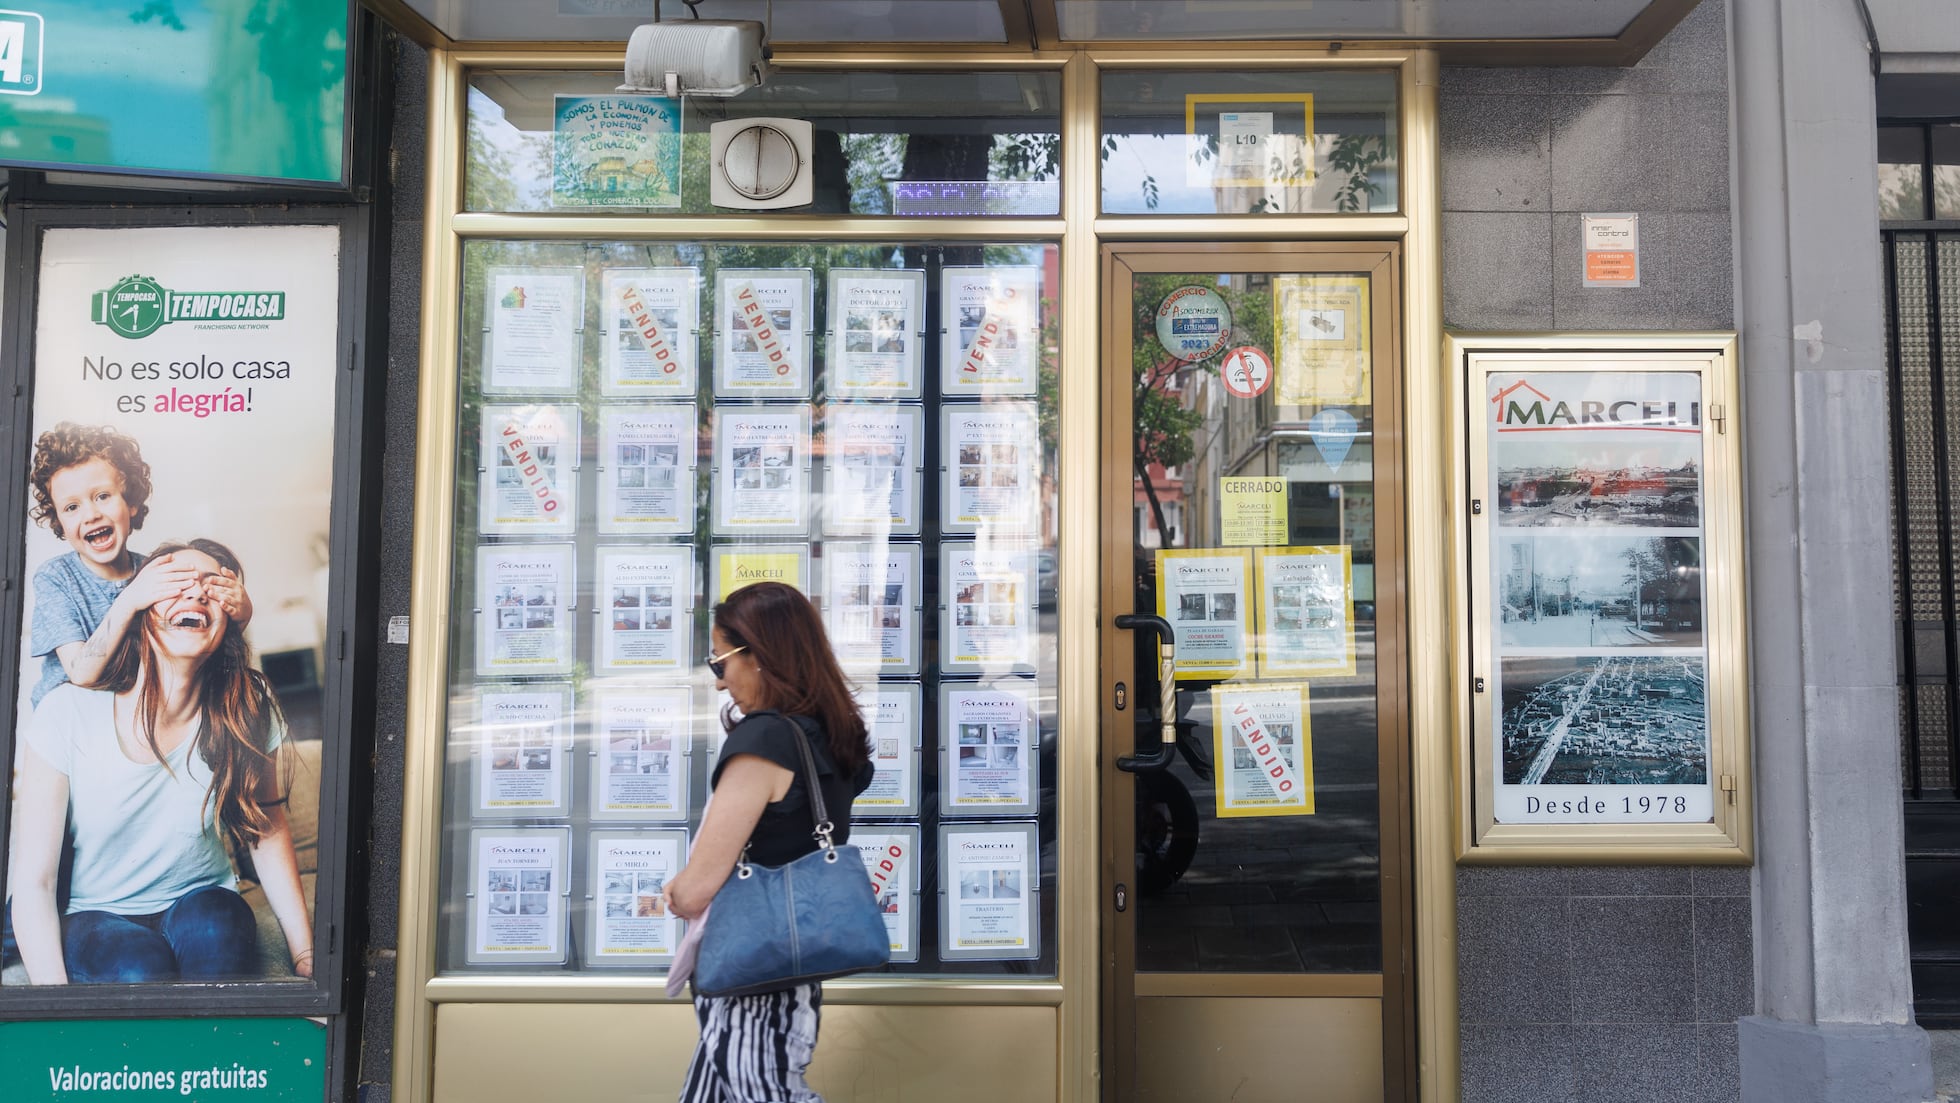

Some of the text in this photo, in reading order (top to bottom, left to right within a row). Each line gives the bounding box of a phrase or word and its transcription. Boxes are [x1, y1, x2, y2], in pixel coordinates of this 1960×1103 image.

[563, 102, 595, 122] SOMOS
[600, 101, 612, 110] EL
[658, 110, 672, 123] DE
[580, 132, 602, 144] TODO
[600, 121, 642, 131] PONEMOS
[1236, 134, 1257, 145] L10
[602, 197, 640, 205] COMERCIO
[117, 292, 156, 302] TEMPOCASA
[171, 294, 280, 318] TEMPOCASA
[1160, 288, 1207, 316] COMERCIO
[623, 288, 676, 374] VENDIDO
[738, 288, 790, 376] VENDIDO
[1182, 340, 1210, 349] 2023
[1188, 329, 1228, 360] ASOCIADO
[82, 354, 290, 380] No es solo casa
[116, 387, 252, 418] es alegría!
[1506, 400, 1699, 426] MARCELI
[502, 426, 557, 512] VENDIDO
[1225, 481, 1282, 493] CERRADO
[739, 569, 783, 578] MARCELI
[1233, 702, 1292, 792] VENDIDO
[1526, 796, 1687, 814] Desde 1978
[50, 1063, 268, 1095] Valoraciones gratuitas
